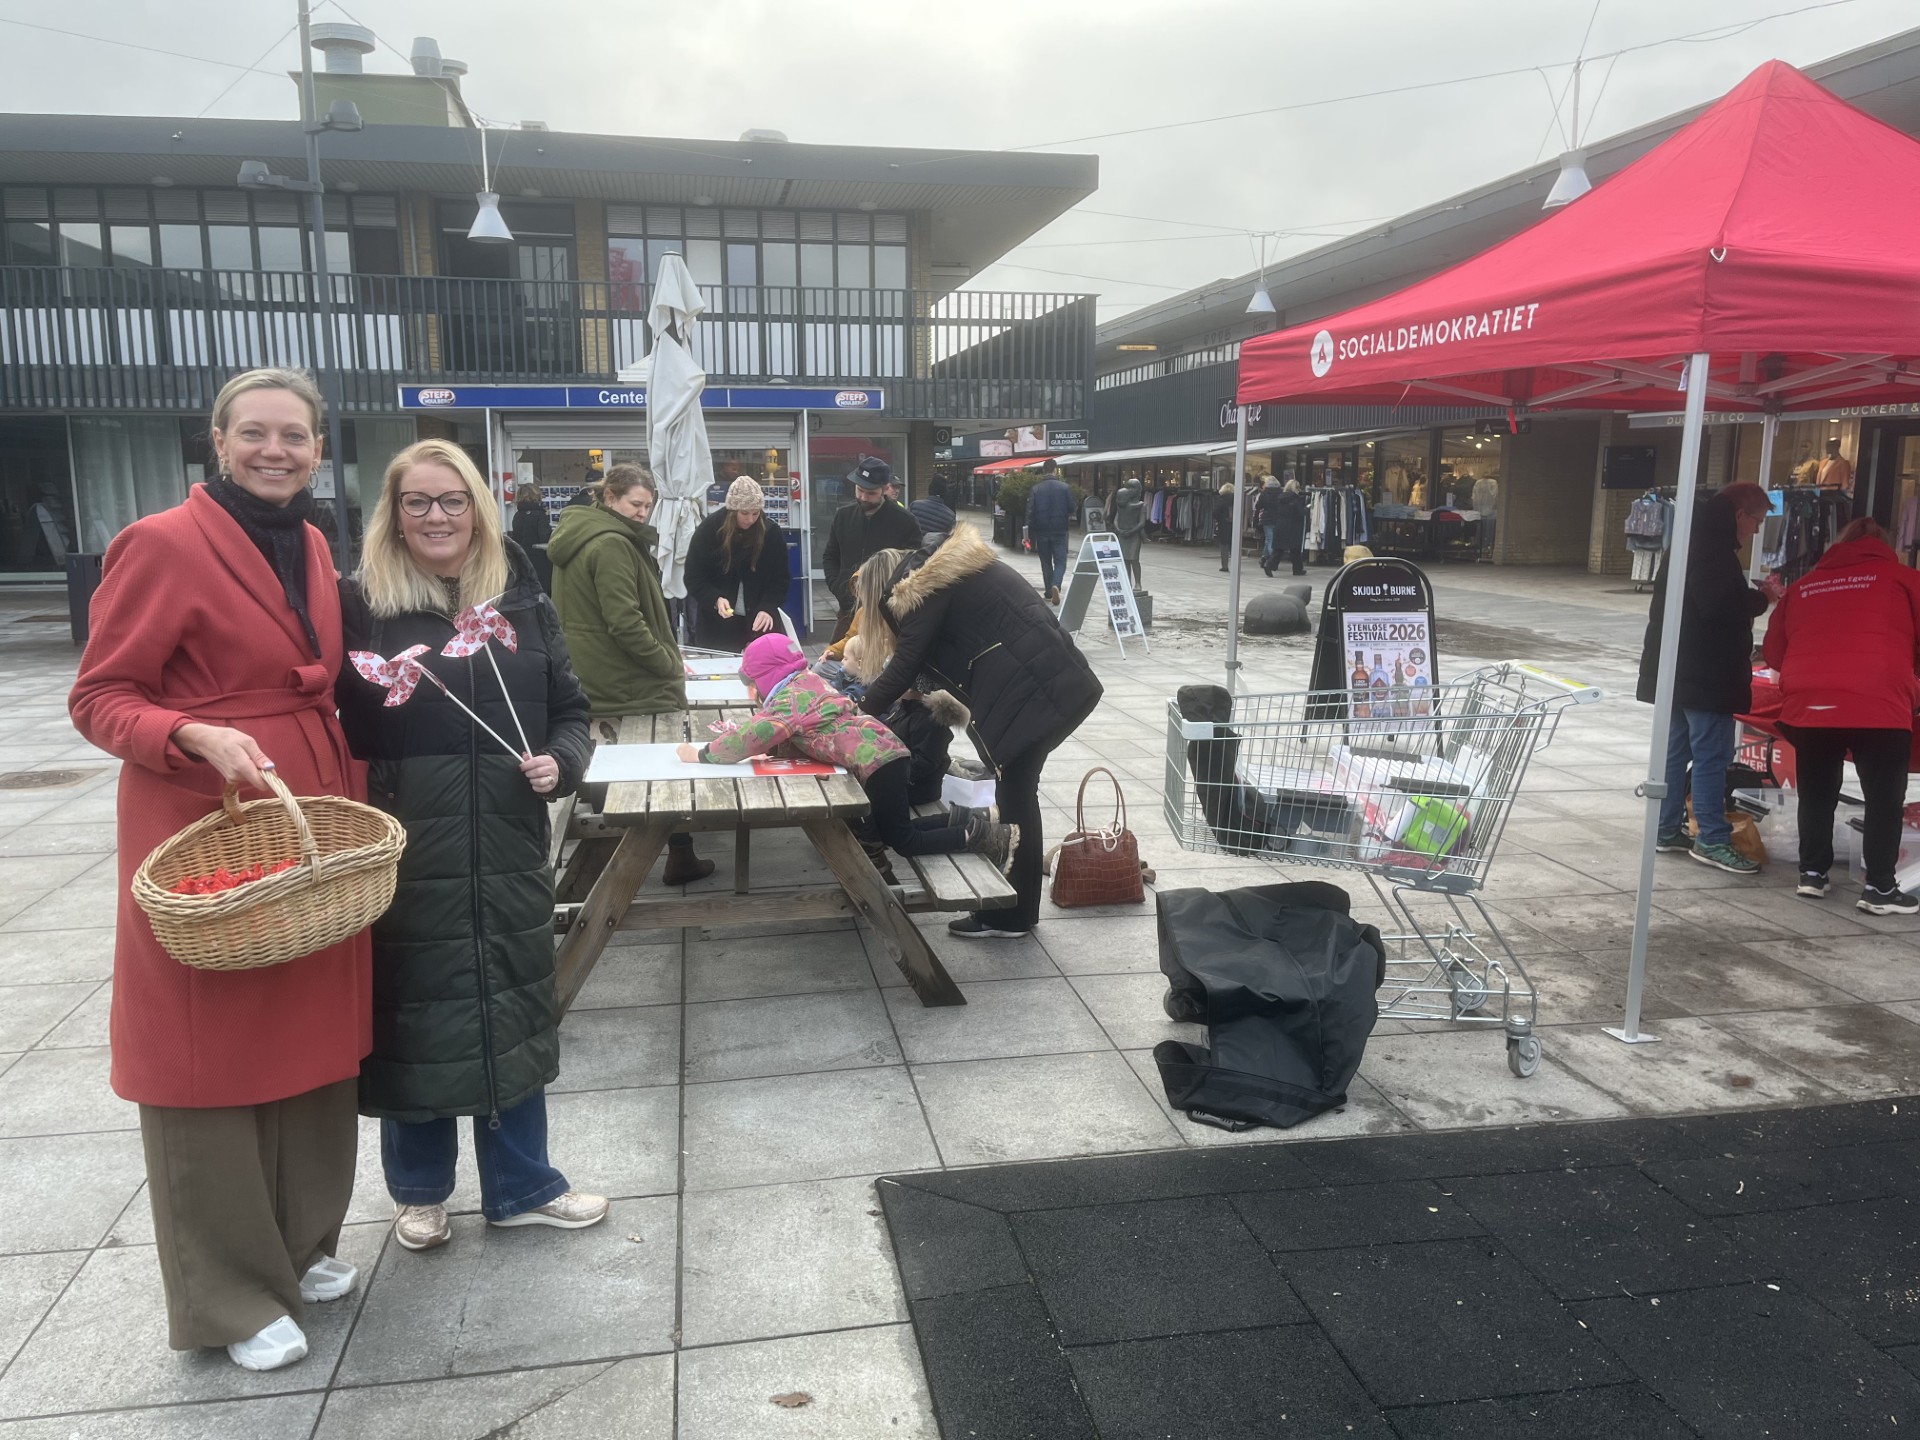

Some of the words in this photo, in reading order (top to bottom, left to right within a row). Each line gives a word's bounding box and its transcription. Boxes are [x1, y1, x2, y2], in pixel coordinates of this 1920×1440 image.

[1339, 302, 1539, 360] SOCIALDEMOKRATIET
[423, 391, 451, 399] STEFF
[841, 393, 864, 401] STEFF
[1840, 403, 1907, 415] DUCKERT
[1666, 413, 1717, 425] DURT
[1728, 412, 1745, 422] CO
[1847, 574, 1877, 583] Egedal
[1352, 585, 1381, 596] SKJOLD
[1390, 585, 1416, 596] BURNE
[1347, 623, 1387, 632] STENLØSE
[1388, 623, 1425, 641] 2026
[1347, 631, 1388, 641] FESTIVAL
